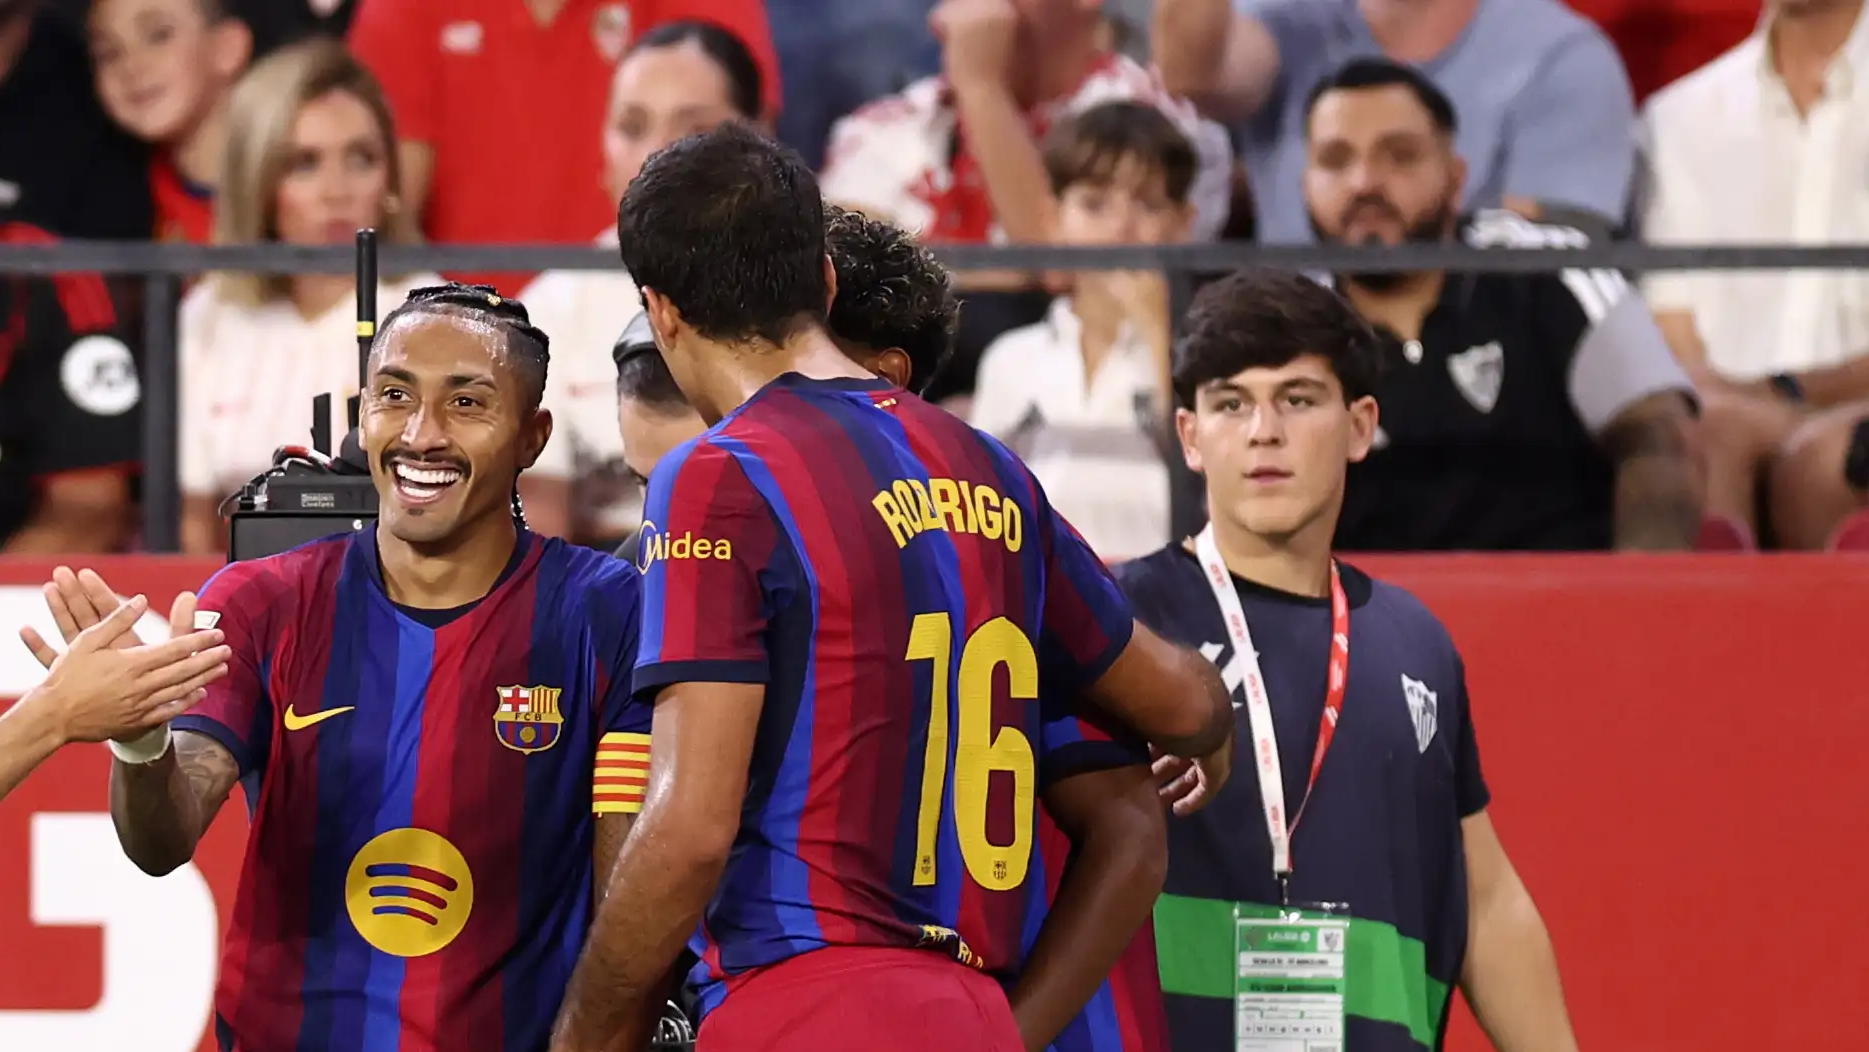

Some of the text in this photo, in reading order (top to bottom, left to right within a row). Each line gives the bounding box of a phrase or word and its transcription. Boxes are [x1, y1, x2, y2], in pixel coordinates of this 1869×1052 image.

[636, 520, 732, 575] Midea
[871, 478, 1022, 552] RODRIGO
[905, 611, 1038, 891] 16
